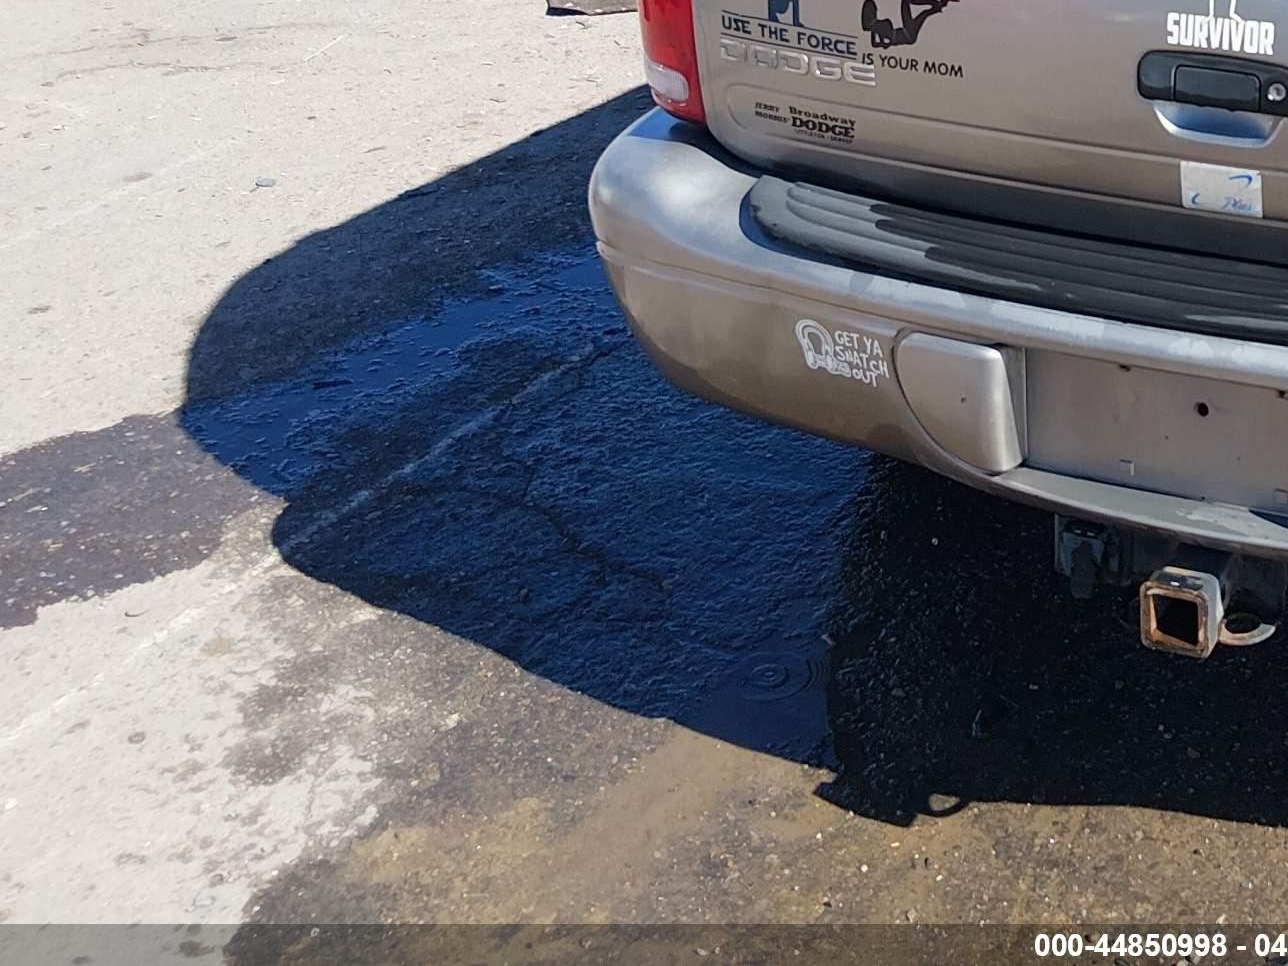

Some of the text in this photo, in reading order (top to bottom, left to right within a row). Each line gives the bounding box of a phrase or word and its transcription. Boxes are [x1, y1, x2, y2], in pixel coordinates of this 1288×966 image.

[721, 15, 857, 55] USE THE FORCE
[1167, 12, 1275, 55] SURVIVOR
[720, 38, 877, 87] DODGE
[862, 53, 964, 78] IS YOUR MOM
[789, 106, 856, 127] Broadway
[791, 116, 855, 139] DODGE
[835, 330, 883, 357] GET YA
[835, 345, 890, 378] SNATCH
[852, 368, 879, 387] OUT
